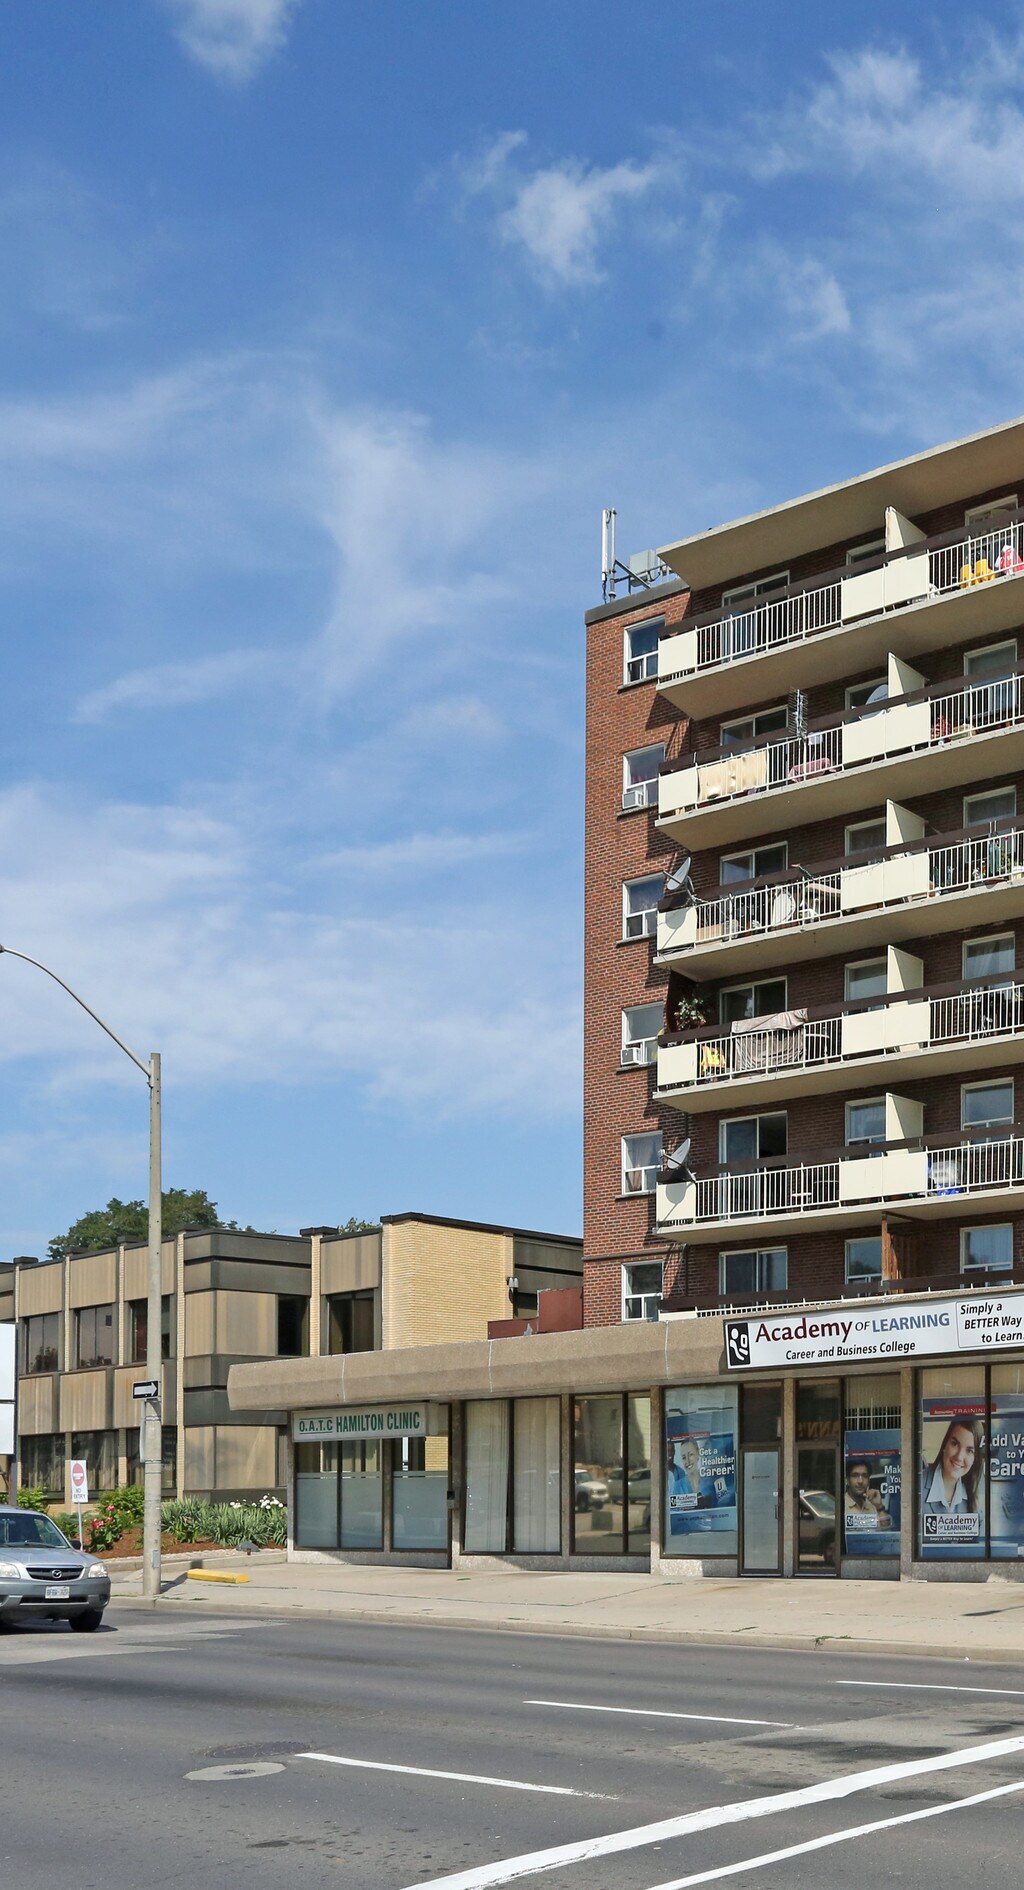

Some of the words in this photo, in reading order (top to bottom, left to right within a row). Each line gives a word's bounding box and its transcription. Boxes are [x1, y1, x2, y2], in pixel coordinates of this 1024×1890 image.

[960, 1302, 993, 1314] Simply
[996, 1303, 1002, 1311] a
[756, 1318, 853, 1342] Academy
[855, 1321, 870, 1331] OF
[872, 1313, 950, 1332] LEARNING
[964, 1317, 999, 1330] BETTER
[1001, 1316, 1022, 1327] Way
[982, 1334, 992, 1343] to
[786, 1350, 815, 1360] Career
[818, 1346, 834, 1358] and
[837, 1344, 877, 1356] Business
[880, 1341, 916, 1354] College
[300, 1420, 332, 1432] O.A.T.C
[336, 1414, 384, 1432] HAMILTON
[387, 1412, 420, 1431] CLINIC
[700, 1448, 712, 1456] Get
[702, 1456, 735, 1466] Healthier
[700, 1464, 735, 1477] Career!
[884, 1466, 902, 1474] Mak
[718, 1482, 722, 1490] U
[880, 1482, 902, 1494] Car
[938, 1515, 978, 1527] Academy
